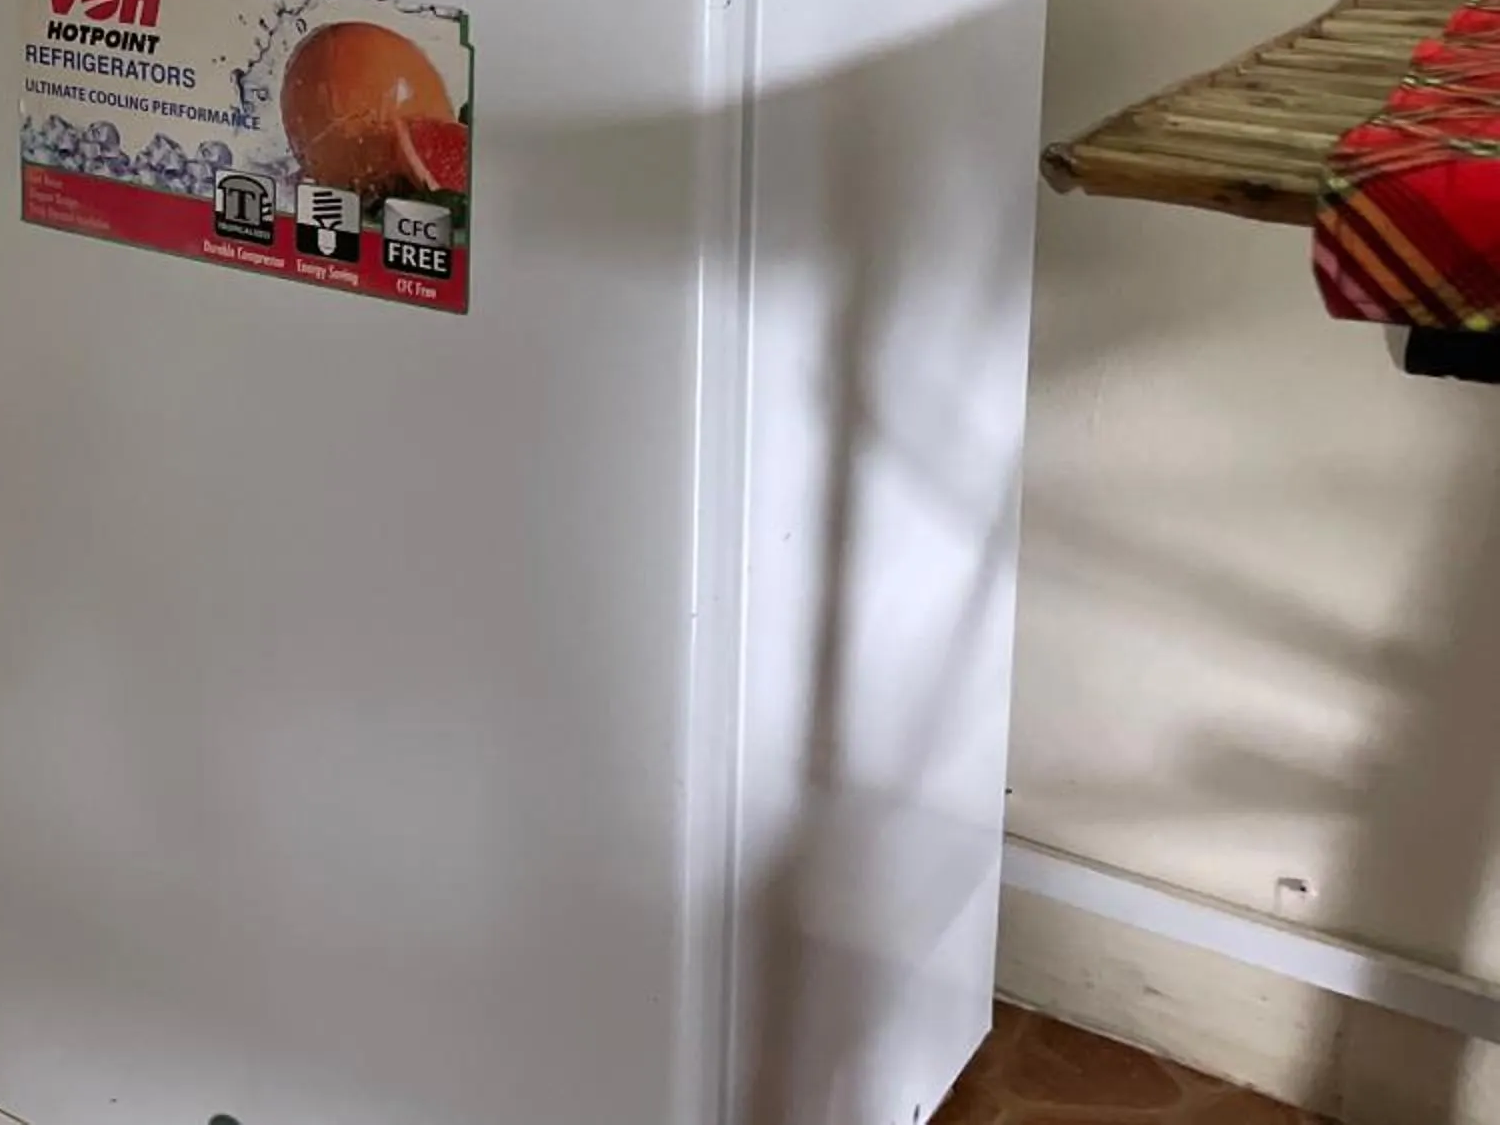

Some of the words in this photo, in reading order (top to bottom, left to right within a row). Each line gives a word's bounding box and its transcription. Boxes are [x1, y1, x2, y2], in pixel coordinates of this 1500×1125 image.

[47, 20, 160, 55] HOTPOINT
[25, 44, 196, 88] REFRIGERATORS
[25, 78, 86, 102] ULTIMATE
[88, 90, 149, 112] COOLING
[152, 100, 261, 130] PERFORMANCE
[397, 218, 437, 240] CFC
[203, 239, 235, 260] Durable
[388, 242, 448, 272] FREE
[296, 258, 328, 280] Energy
[396, 277, 414, 296] CFC
[415, 281, 437, 299] Free
